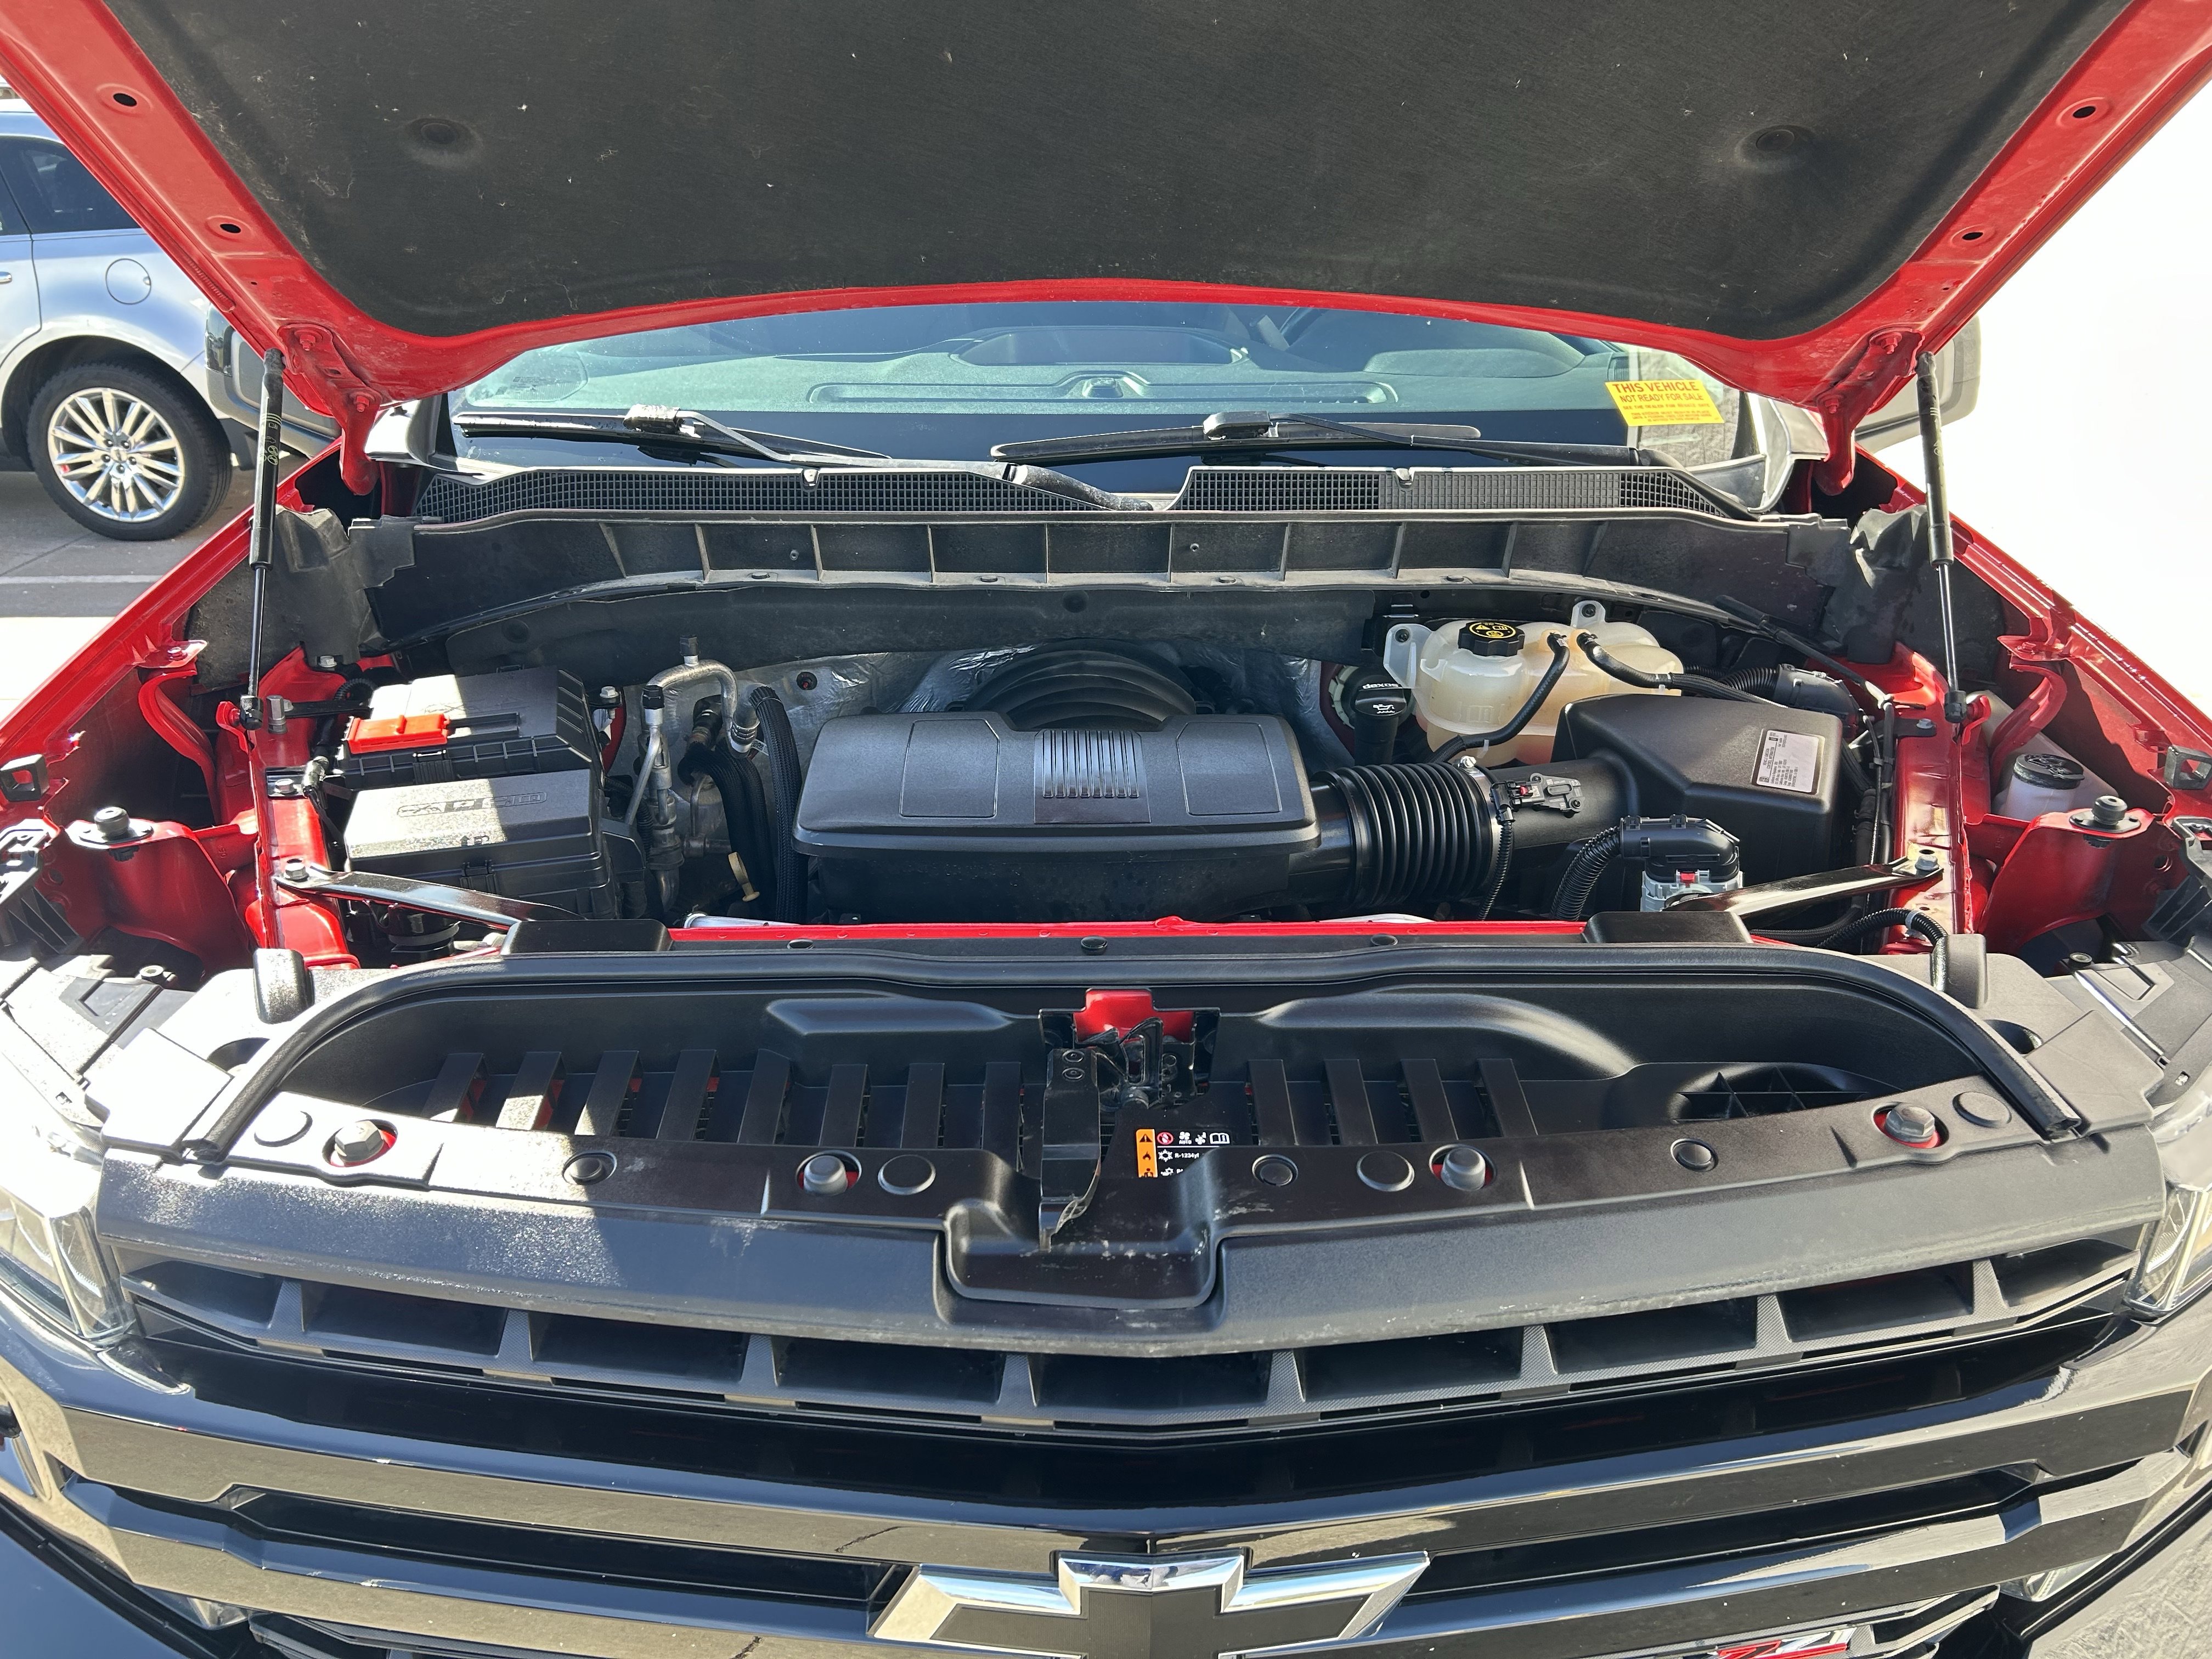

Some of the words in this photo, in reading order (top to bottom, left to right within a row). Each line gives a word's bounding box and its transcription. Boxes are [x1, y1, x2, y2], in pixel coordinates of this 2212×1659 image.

[1612, 383, 1644, 393] THIS
[1647, 382, 1700, 392] VEHICLE
[1620, 394, 1637, 403] NOT
